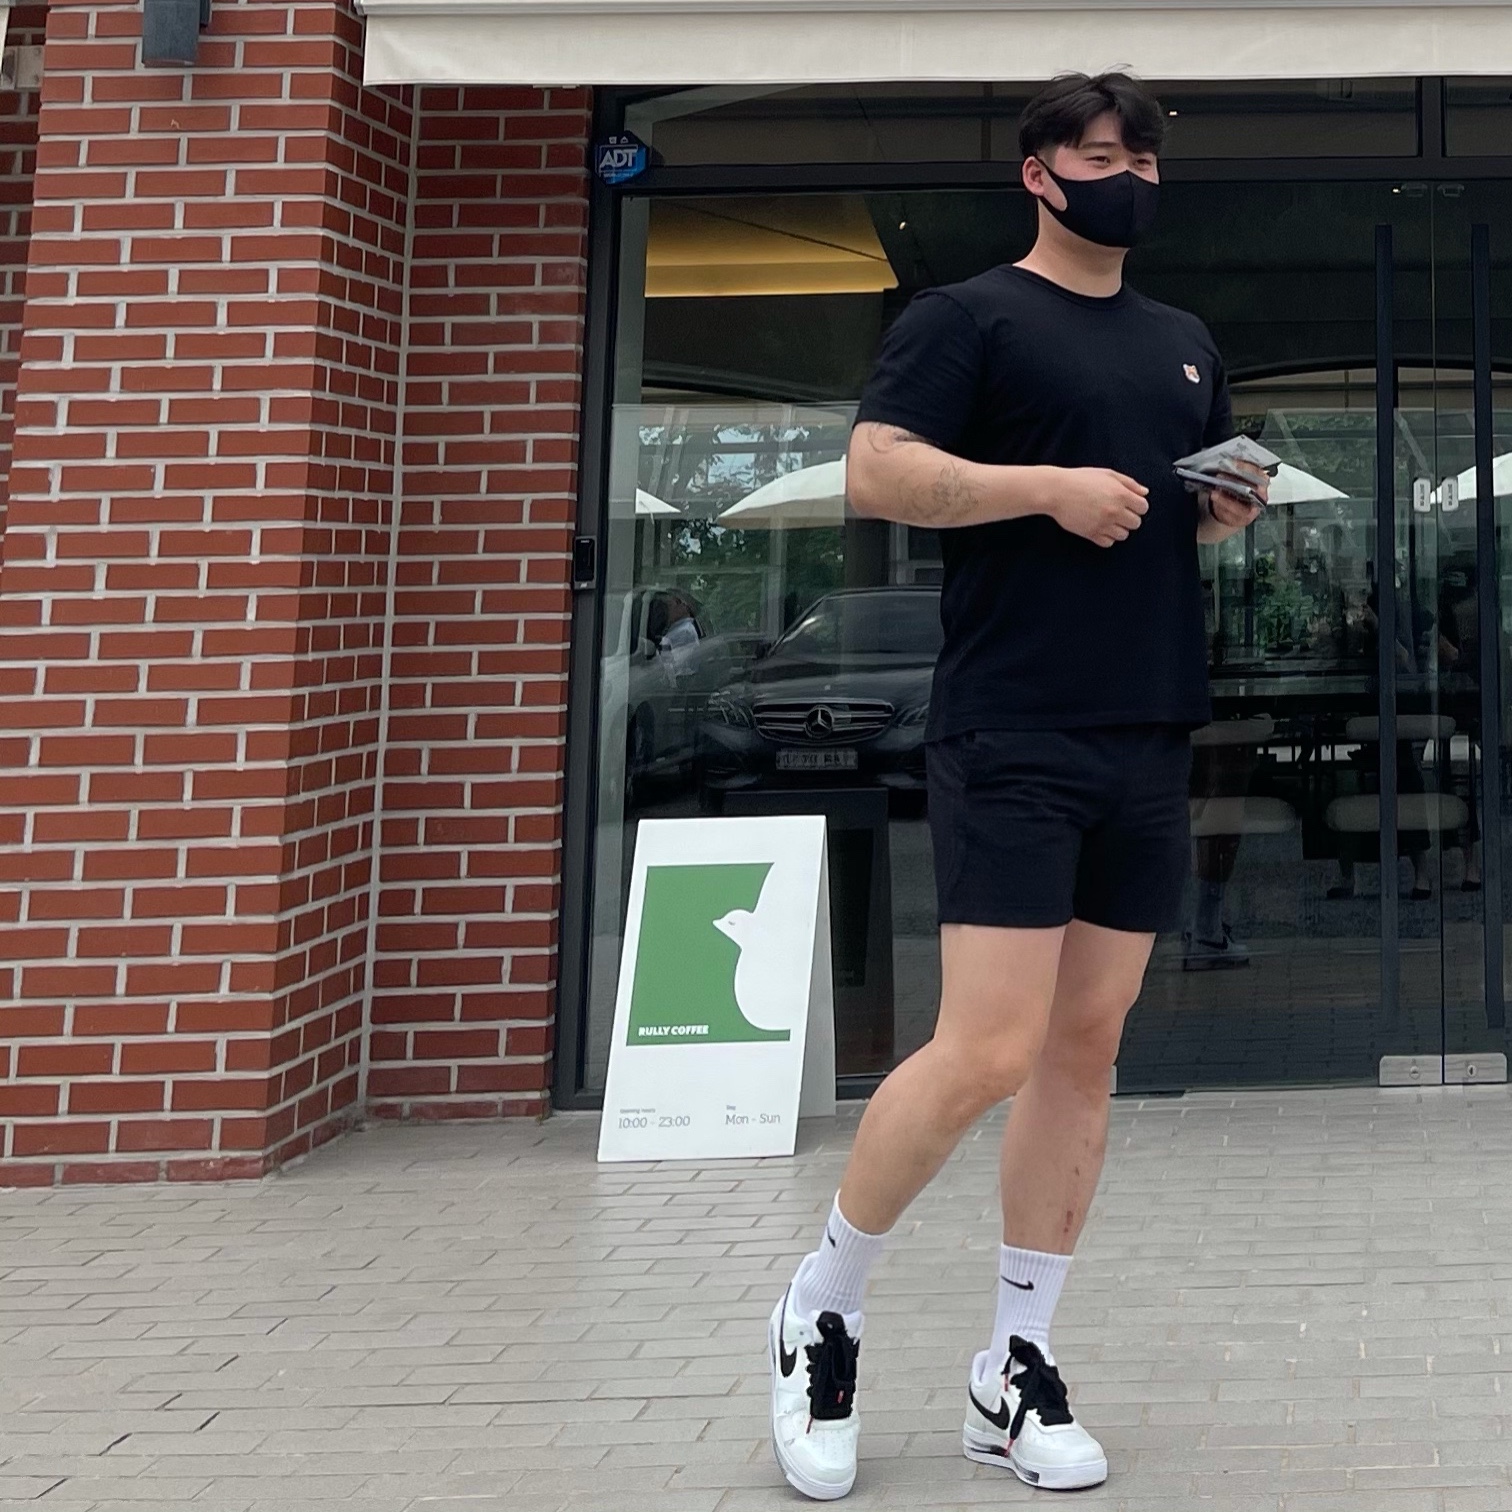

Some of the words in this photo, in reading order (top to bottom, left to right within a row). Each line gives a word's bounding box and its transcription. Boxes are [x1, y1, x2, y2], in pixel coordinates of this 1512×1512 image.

[599, 149, 637, 168] ADT
[638, 1026, 670, 1036] RULLY
[671, 1024, 709, 1036] COFFEE
[618, 1117, 648, 1129] 10:00
[658, 1116, 691, 1128] 23:00
[725, 1114, 749, 1125] Mon
[759, 1113, 781, 1124] Sun
